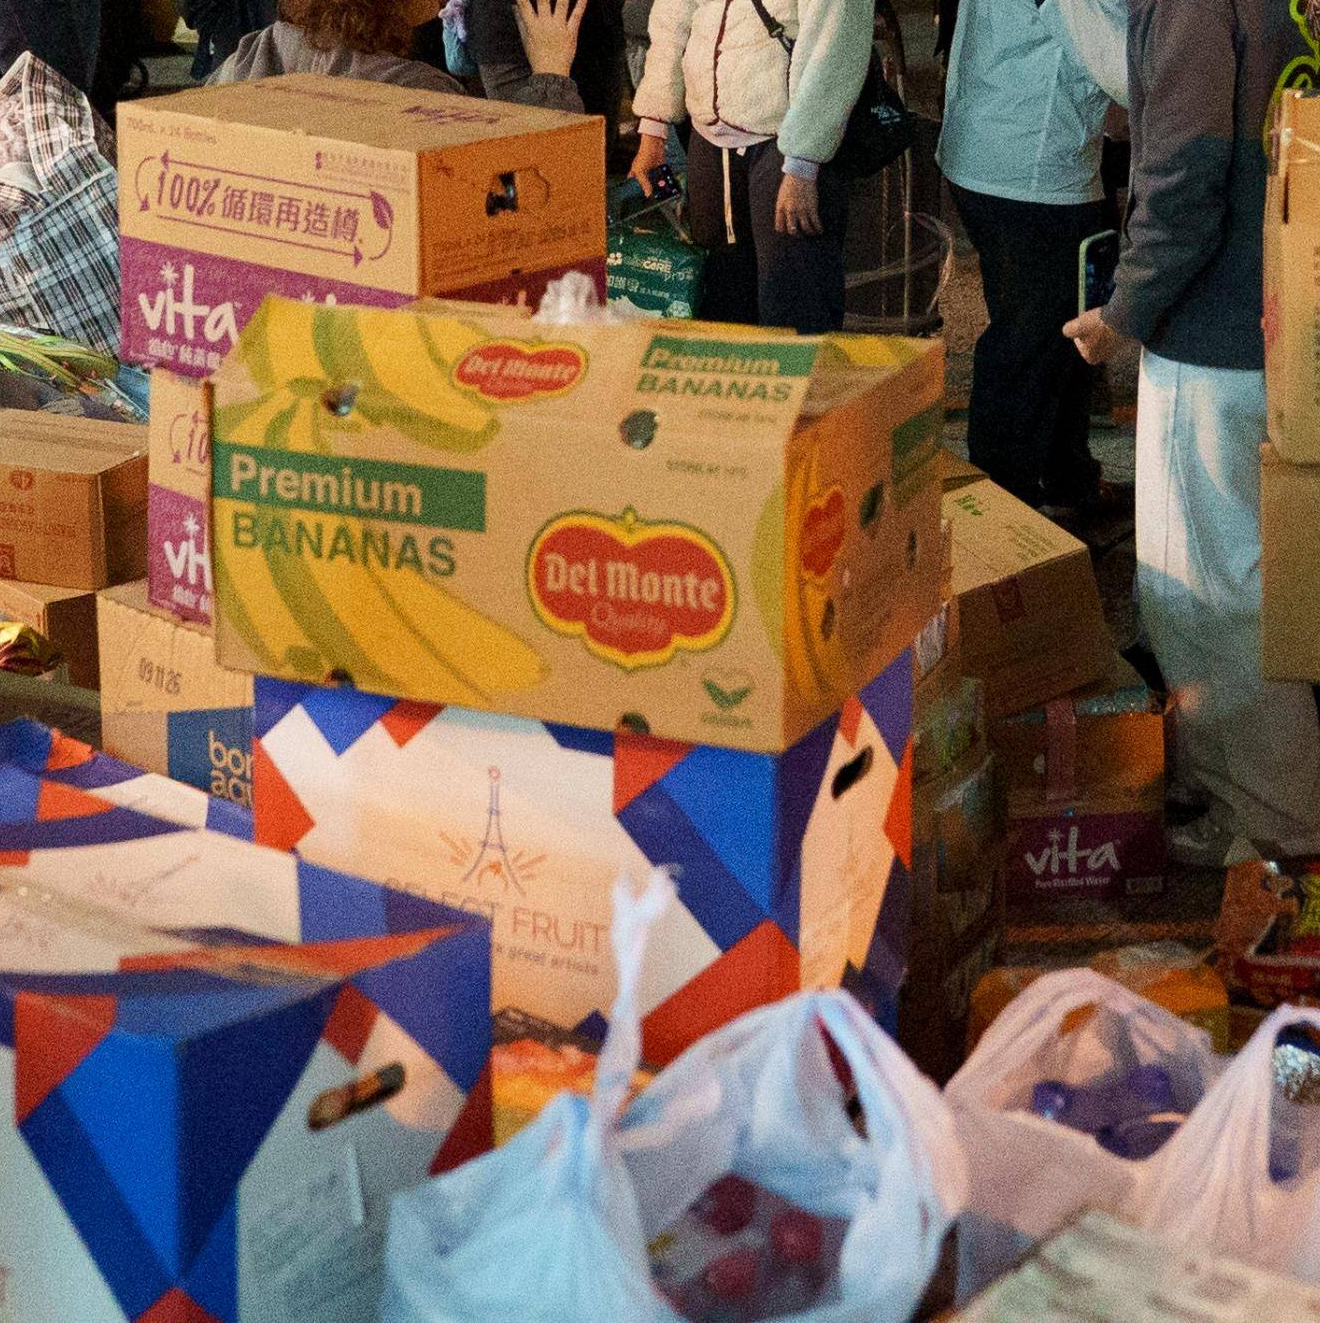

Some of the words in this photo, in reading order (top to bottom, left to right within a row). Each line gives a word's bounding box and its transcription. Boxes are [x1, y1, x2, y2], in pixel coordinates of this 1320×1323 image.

[137, 262, 240, 345] vita
[463, 353, 499, 377] Del
[501, 357, 578, 383] Monte
[635, 373, 793, 404] BANANAS
[229, 452, 423, 517] Premium
[232, 509, 457, 578] BANANAS
[543, 551, 599, 597] Del
[605, 558, 722, 613] Monte
[1024, 826, 1122, 875] vita
[510, 906, 610, 953] FRUIT
